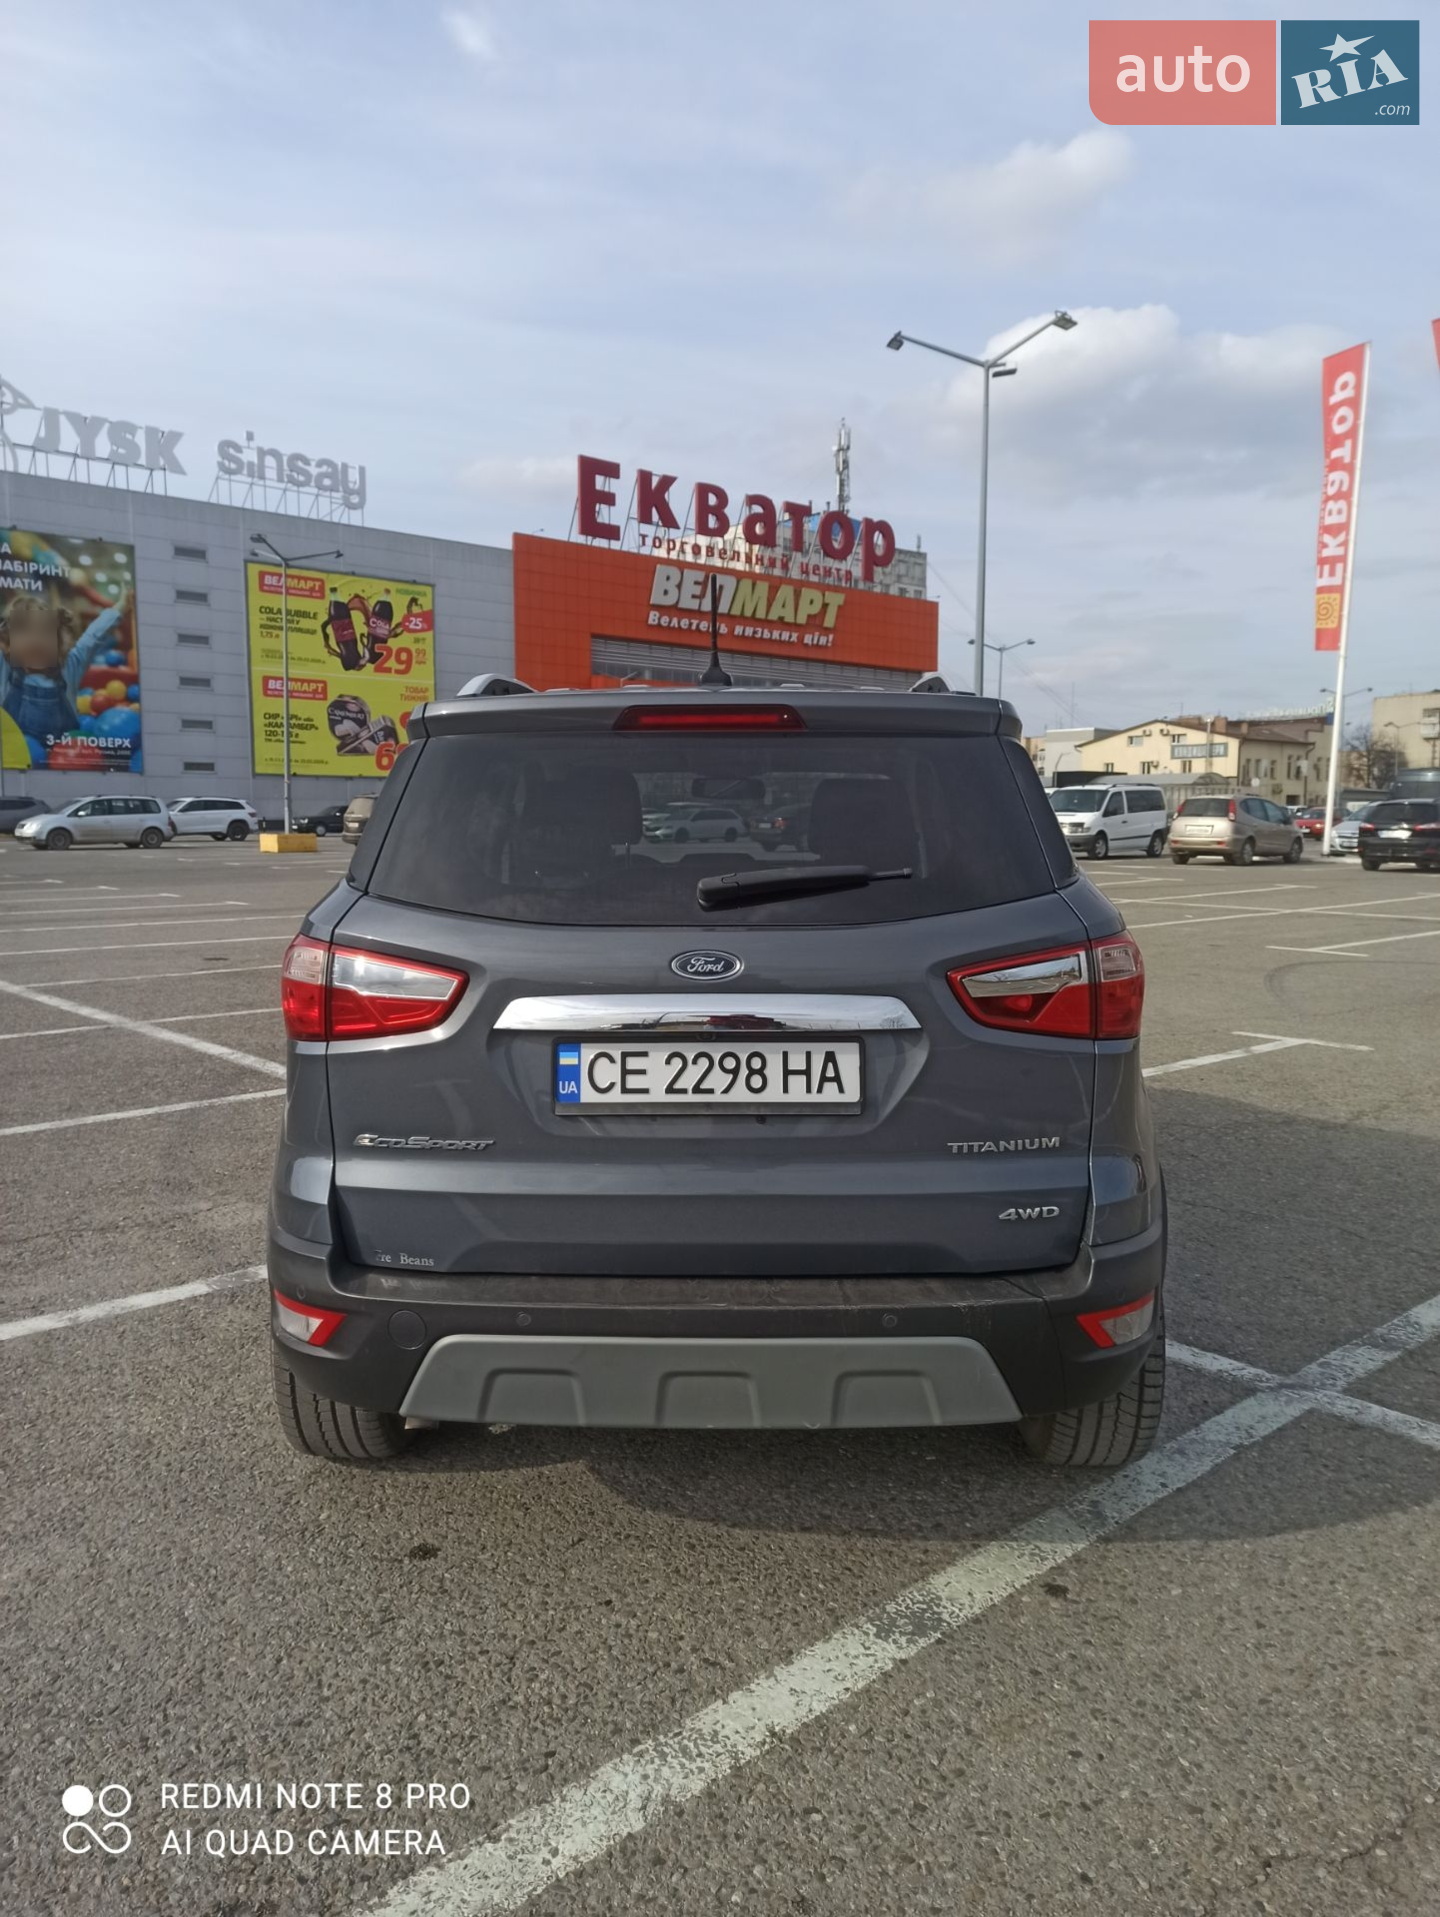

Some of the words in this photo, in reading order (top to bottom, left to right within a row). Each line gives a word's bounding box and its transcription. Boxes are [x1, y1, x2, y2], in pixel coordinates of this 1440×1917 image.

[31, 407, 187, 476] JYSK
[217, 430, 366, 510] sinsay
[648, 564, 845, 629] ВЕЛМАРТ
[373, 643, 414, 676] 29
[46, 732, 72, 746] 3-Й
[77, 735, 132, 749] ПОВЕРХ
[686, 956, 725, 973] Ford
[587, 1050, 650, 1095] CE
[663, 1050, 768, 1095] 2298
[781, 1050, 845, 1095] HA
[559, 1081, 578, 1094] UA
[946, 1136, 1061, 1154] TITANIUM
[998, 1205, 1060, 1221] 4WD
[399, 1252, 435, 1268] Beans
